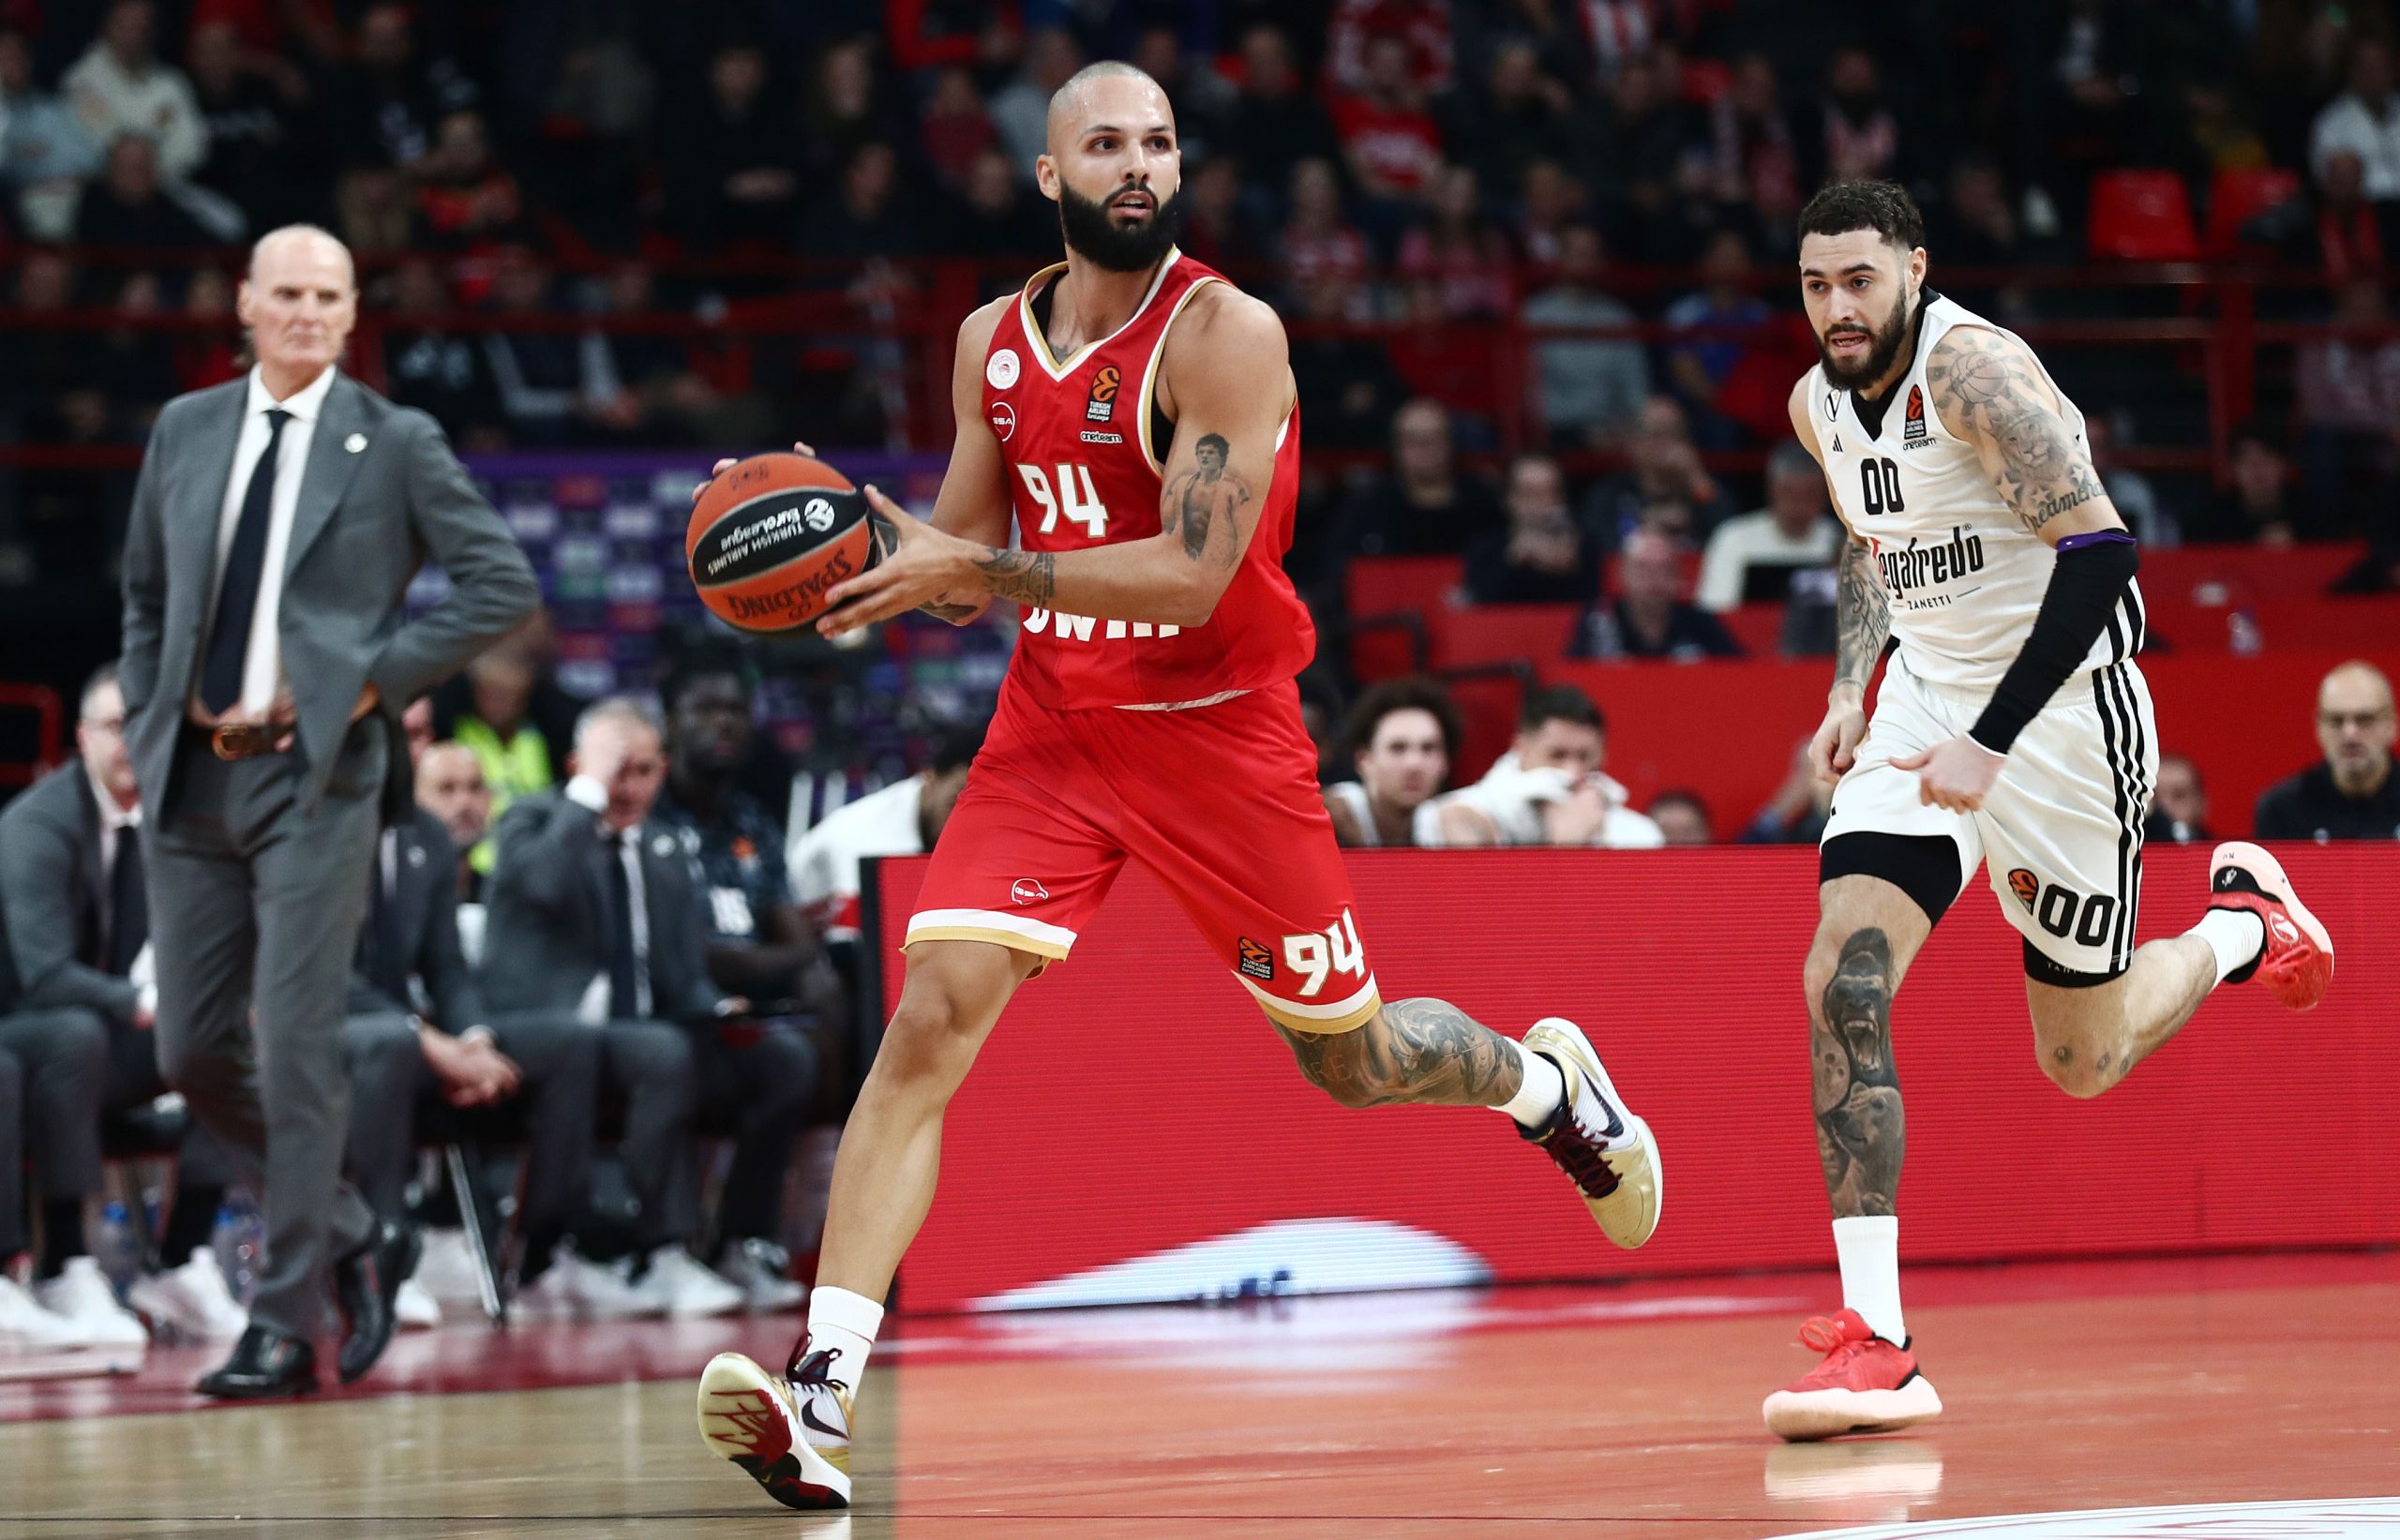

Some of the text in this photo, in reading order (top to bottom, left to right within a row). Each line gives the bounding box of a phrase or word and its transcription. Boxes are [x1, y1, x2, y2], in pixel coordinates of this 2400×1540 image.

[1081, 431, 1122, 443] oneteam
[1902, 438, 1937, 450] oneteam
[1015, 462, 1110, 539] 94
[1860, 457, 1905, 516] 00
[708, 520, 805, 576] TURKISH AIRLINES
[723, 549, 851, 619] SPALDING
[1907, 594, 1952, 611] ZANETTI
[2038, 883, 2116, 948] 00
[1281, 905, 1366, 997] 94
